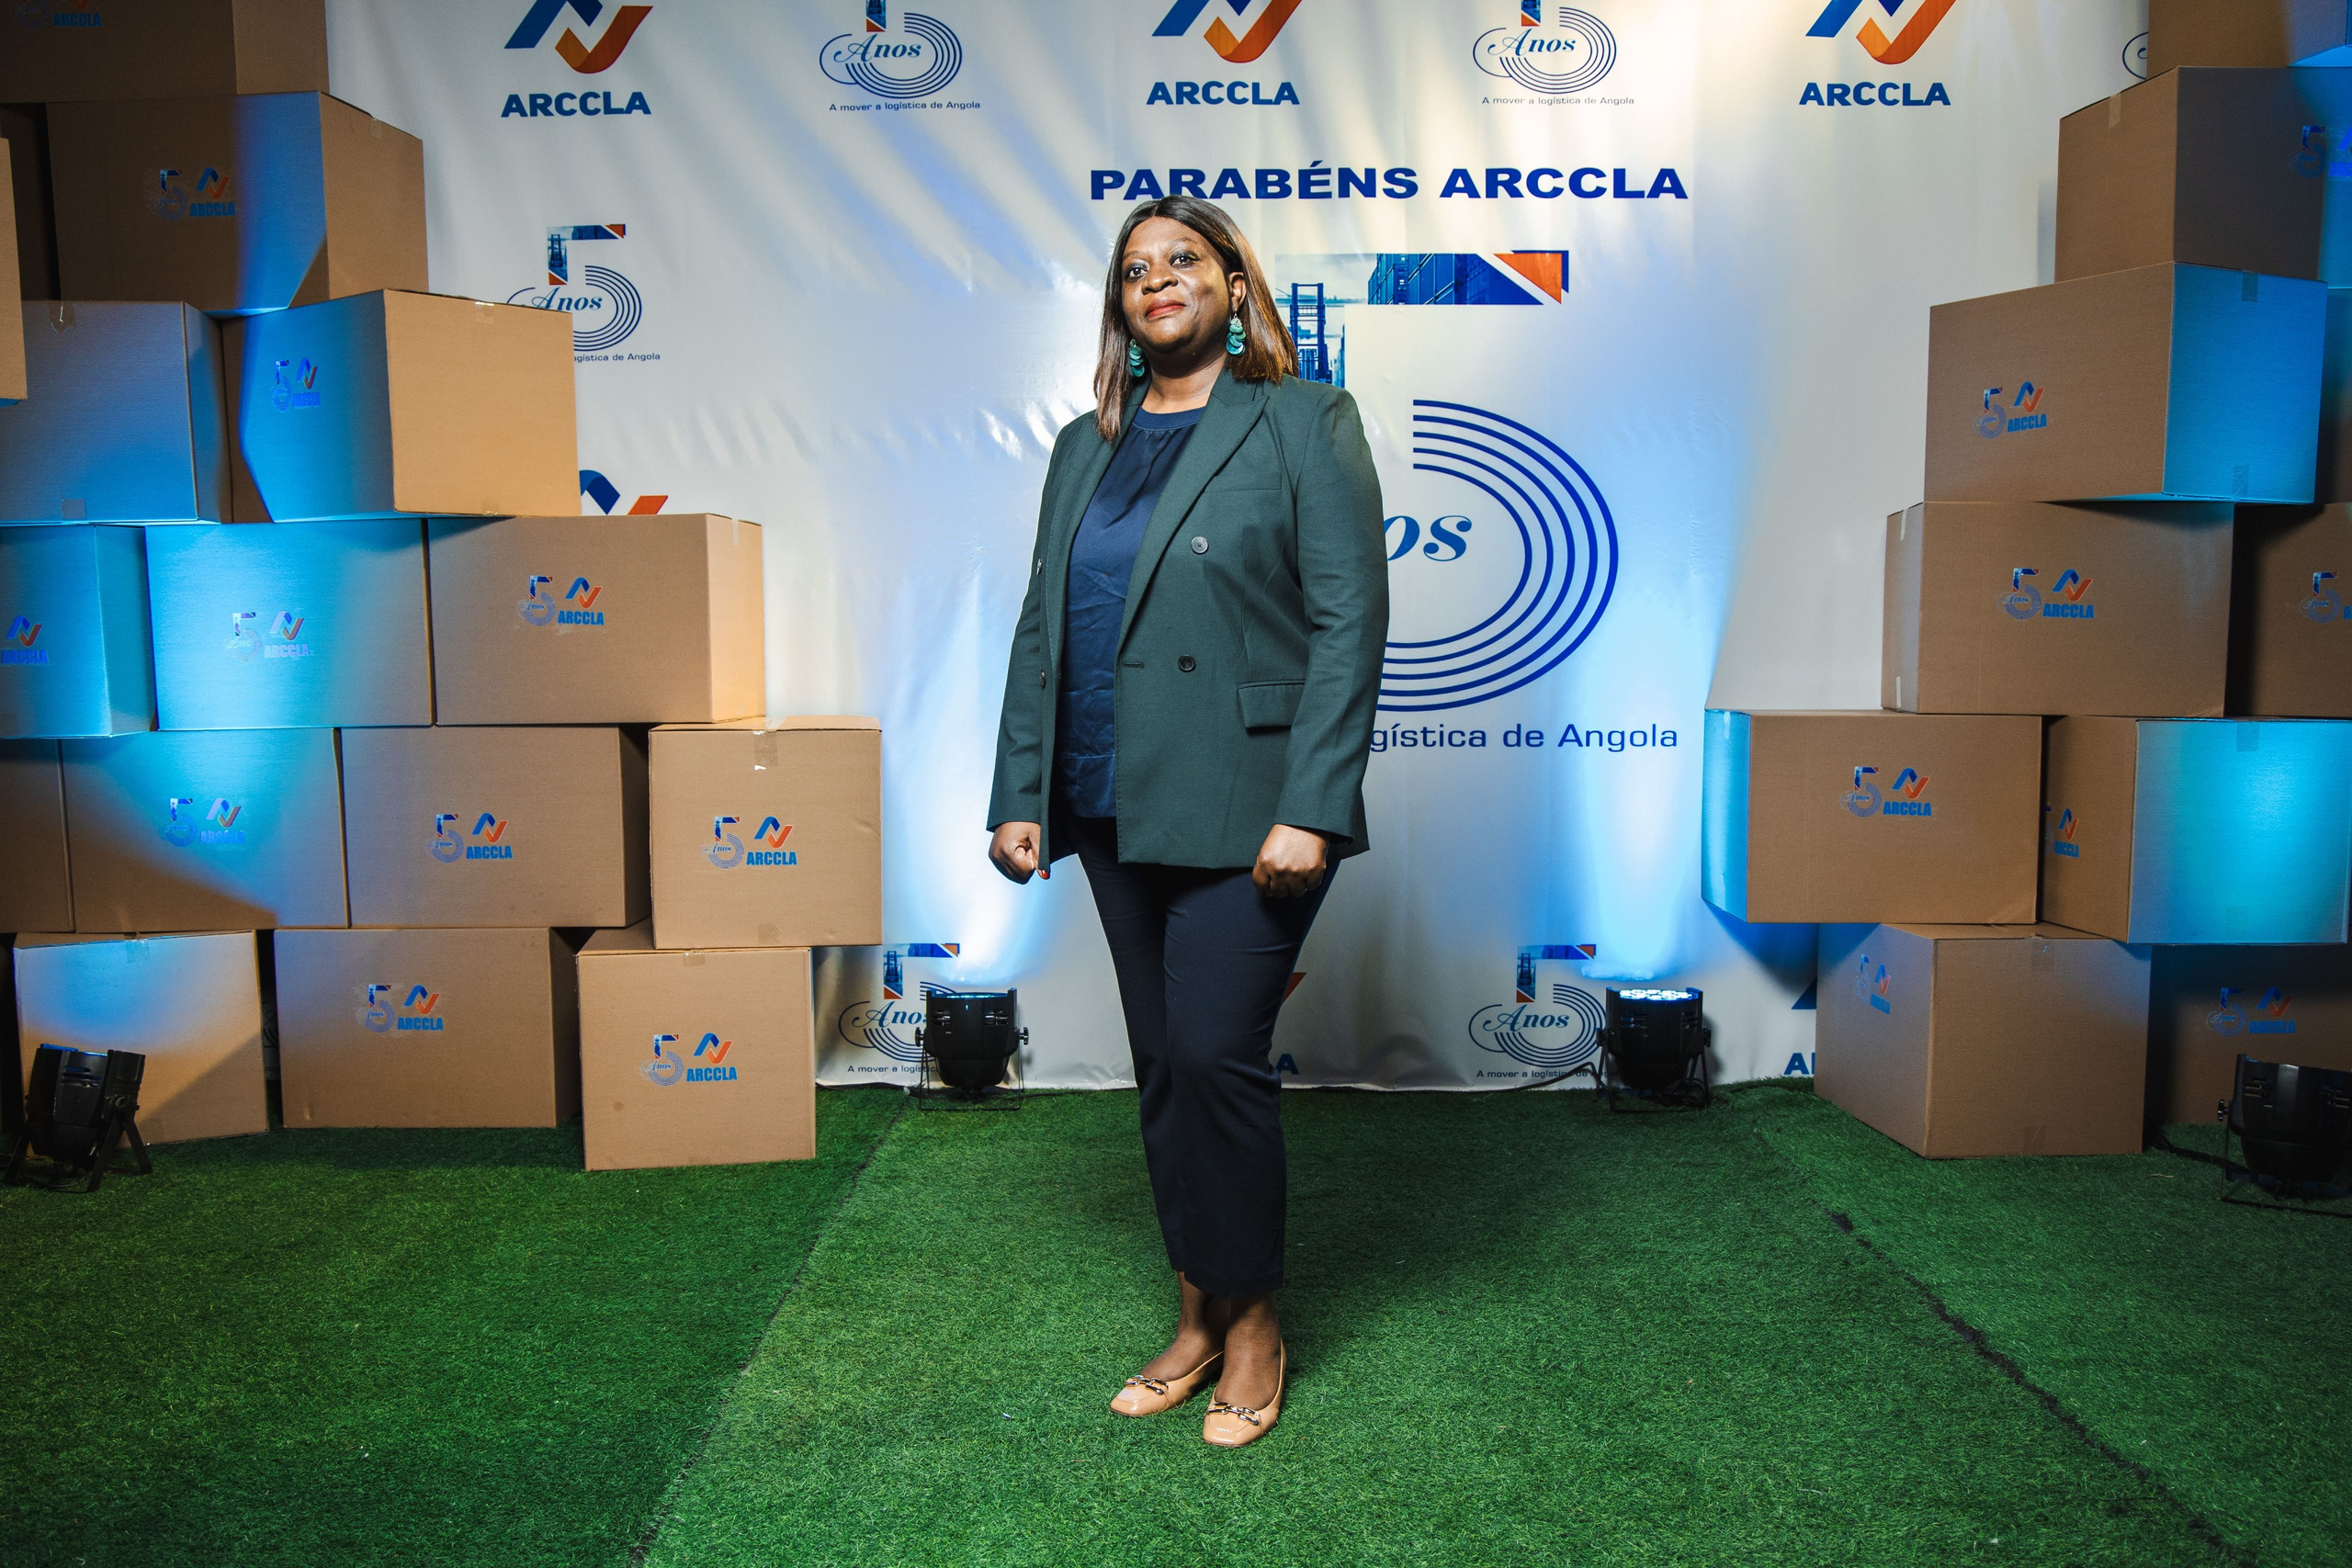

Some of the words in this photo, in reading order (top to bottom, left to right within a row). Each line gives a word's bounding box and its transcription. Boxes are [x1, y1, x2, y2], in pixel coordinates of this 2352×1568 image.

[53, 13, 103, 28] ARCCLA
[833, 33, 922, 63] Anos
[1487, 28, 1577, 57] Anos
[1146, 81, 1300, 106] ARCCLA
[1481, 96, 1489, 105] A
[1538, 96, 1580, 106] logística
[1600, 96, 1634, 106] Angola
[1798, 81, 1951, 107] ARCCLA
[501, 91, 651, 118] ARCCLA
[885, 101, 927, 111] logística
[930, 101, 943, 109] de
[945, 101, 980, 110] Angola
[1091, 160, 1418, 200] PARABÉNS
[1439, 167, 1689, 199] ARCCLA
[189, 202, 236, 218] ARCCLA
[531, 287, 603, 311] Anos
[627, 353, 661, 362] Angola
[2007, 413, 2048, 434] ARCCLA
[1383, 514, 1472, 562] os
[557, 610, 605, 626] ARCCLA
[2041, 604, 2095, 619] ARCCLA
[264, 643, 311, 658] ARCCLA
[1370, 723, 1487, 752] gística
[1503, 723, 1544, 748] de
[1557, 723, 1678, 752] Angola
[1883, 801, 1932, 817] ARCCLA
[199, 830, 246, 844] ARCCLA
[466, 845, 514, 860] ARCCLA
[704, 842, 732, 853] Anos
[746, 851, 797, 866] ARCCLA
[397, 1017, 445, 1031] ARCCLA
[1482, 1003, 1570, 1032] Anos
[643, 1058, 673, 1072] Anos
[900, 1065, 938, 1074] logístic
[685, 1066, 739, 1082] ARCCLA
